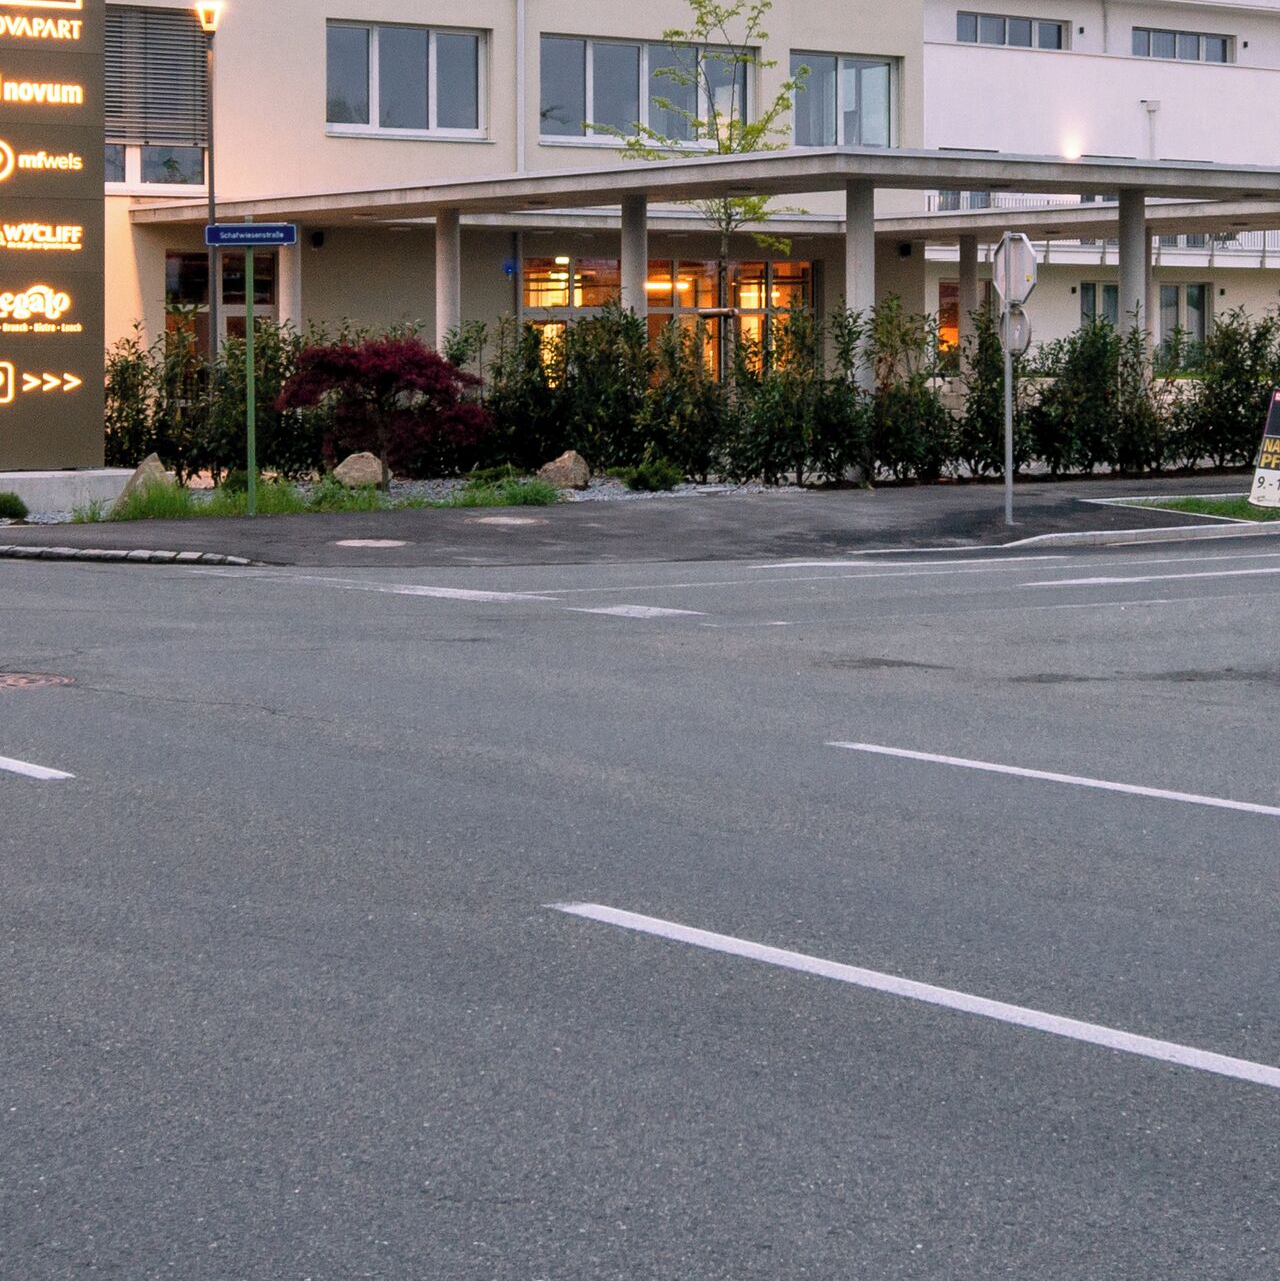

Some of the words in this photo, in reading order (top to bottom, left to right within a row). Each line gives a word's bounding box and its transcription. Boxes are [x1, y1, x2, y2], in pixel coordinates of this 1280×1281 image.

[3, 81, 83, 104] novum
[18, 151, 83, 170] mfwels
[3, 223, 82, 243] WYCLIFF
[1257, 476, 1266, 489] 9.
